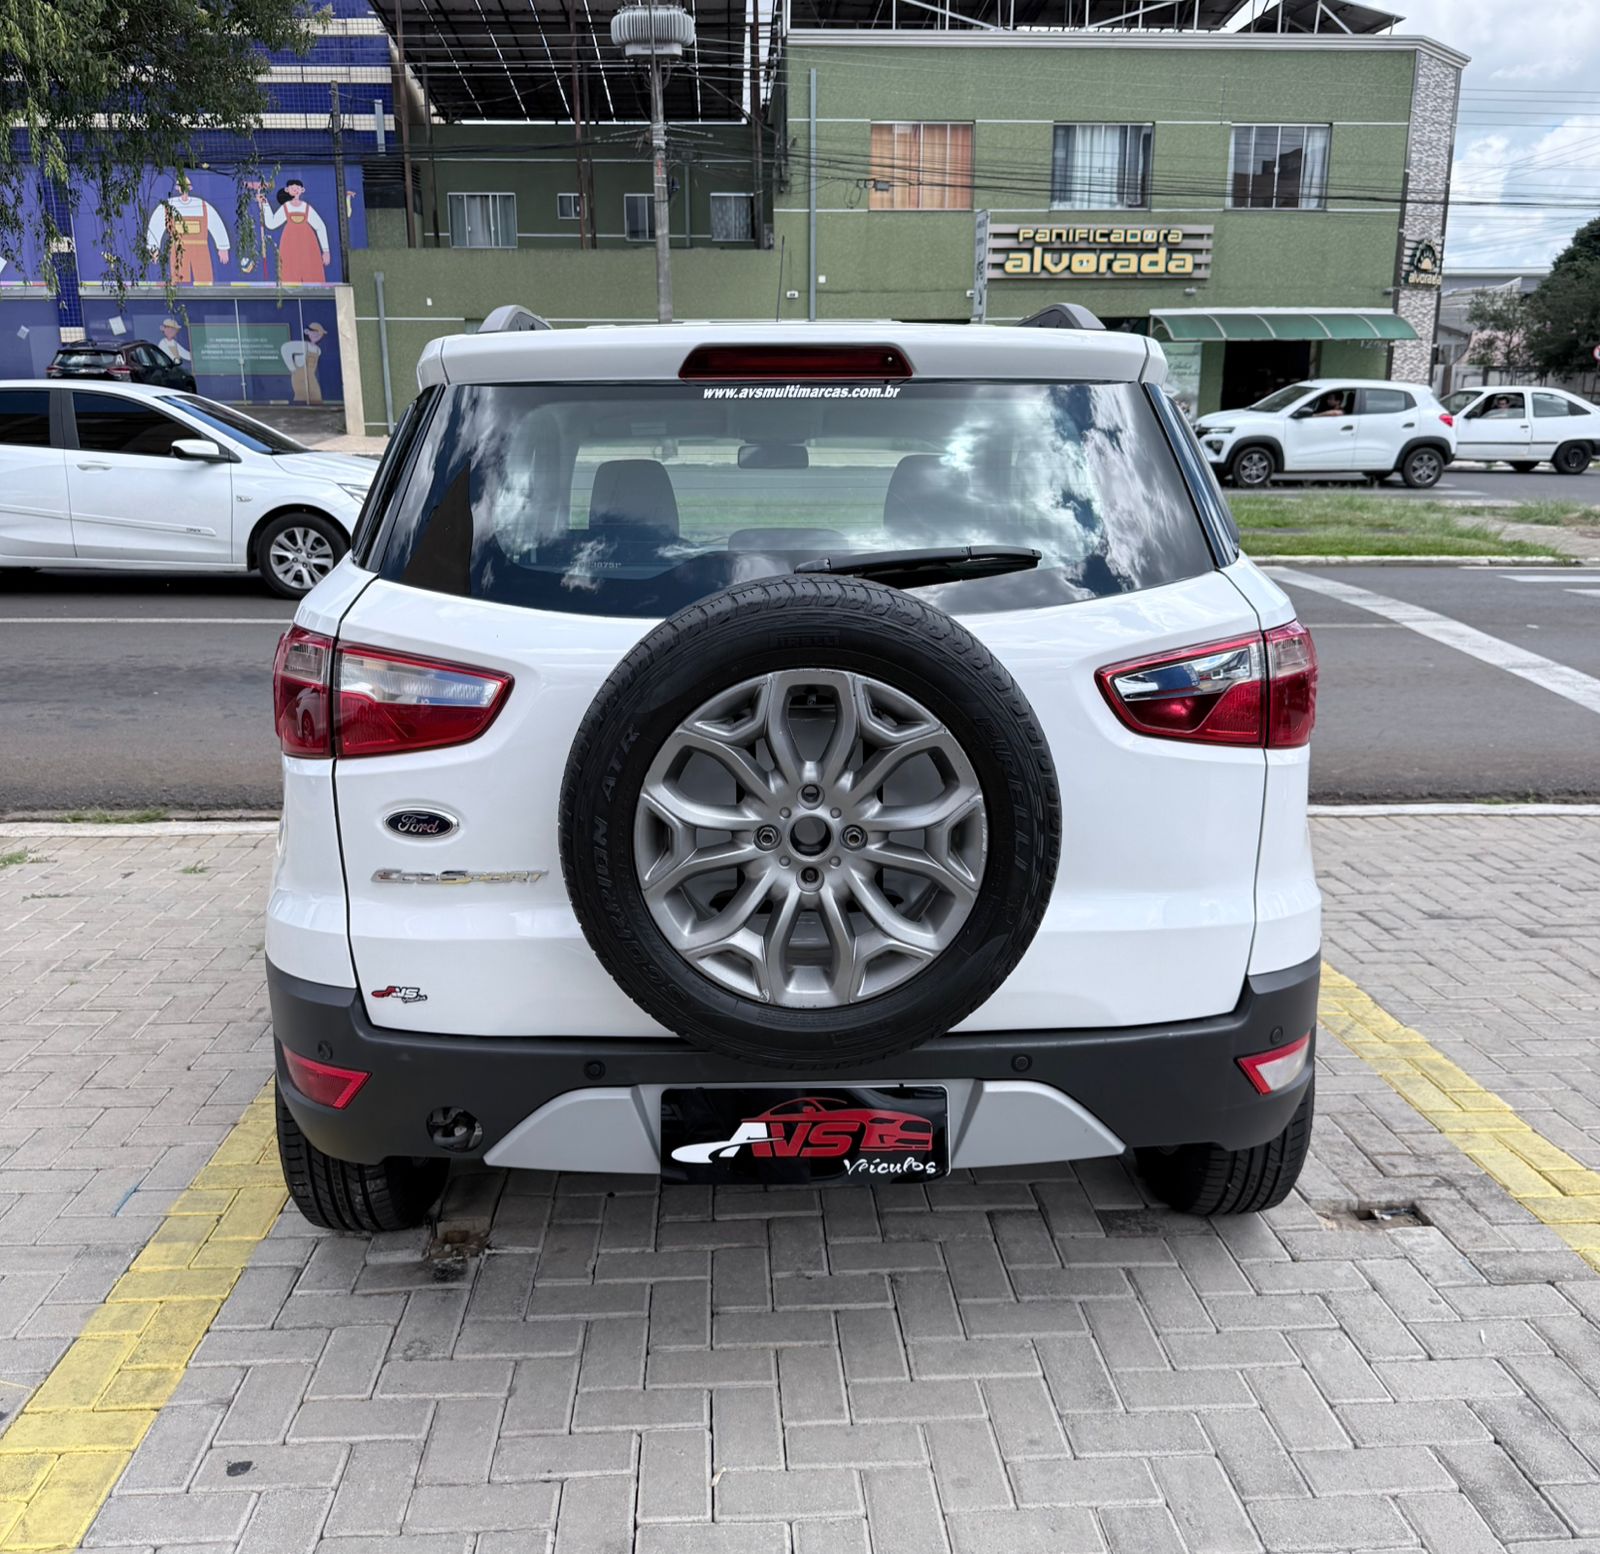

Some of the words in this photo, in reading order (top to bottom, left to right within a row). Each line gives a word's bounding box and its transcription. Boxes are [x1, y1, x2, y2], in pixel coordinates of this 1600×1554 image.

[1004, 247, 1194, 274] alvorada
[703, 384, 900, 398] www.avsmultimarcas.com.br
[601, 723, 641, 801] ATR
[975, 717, 1030, 872] PIRELLI
[397, 812, 440, 834] Ford
[716, 1122, 861, 1158] AVS
